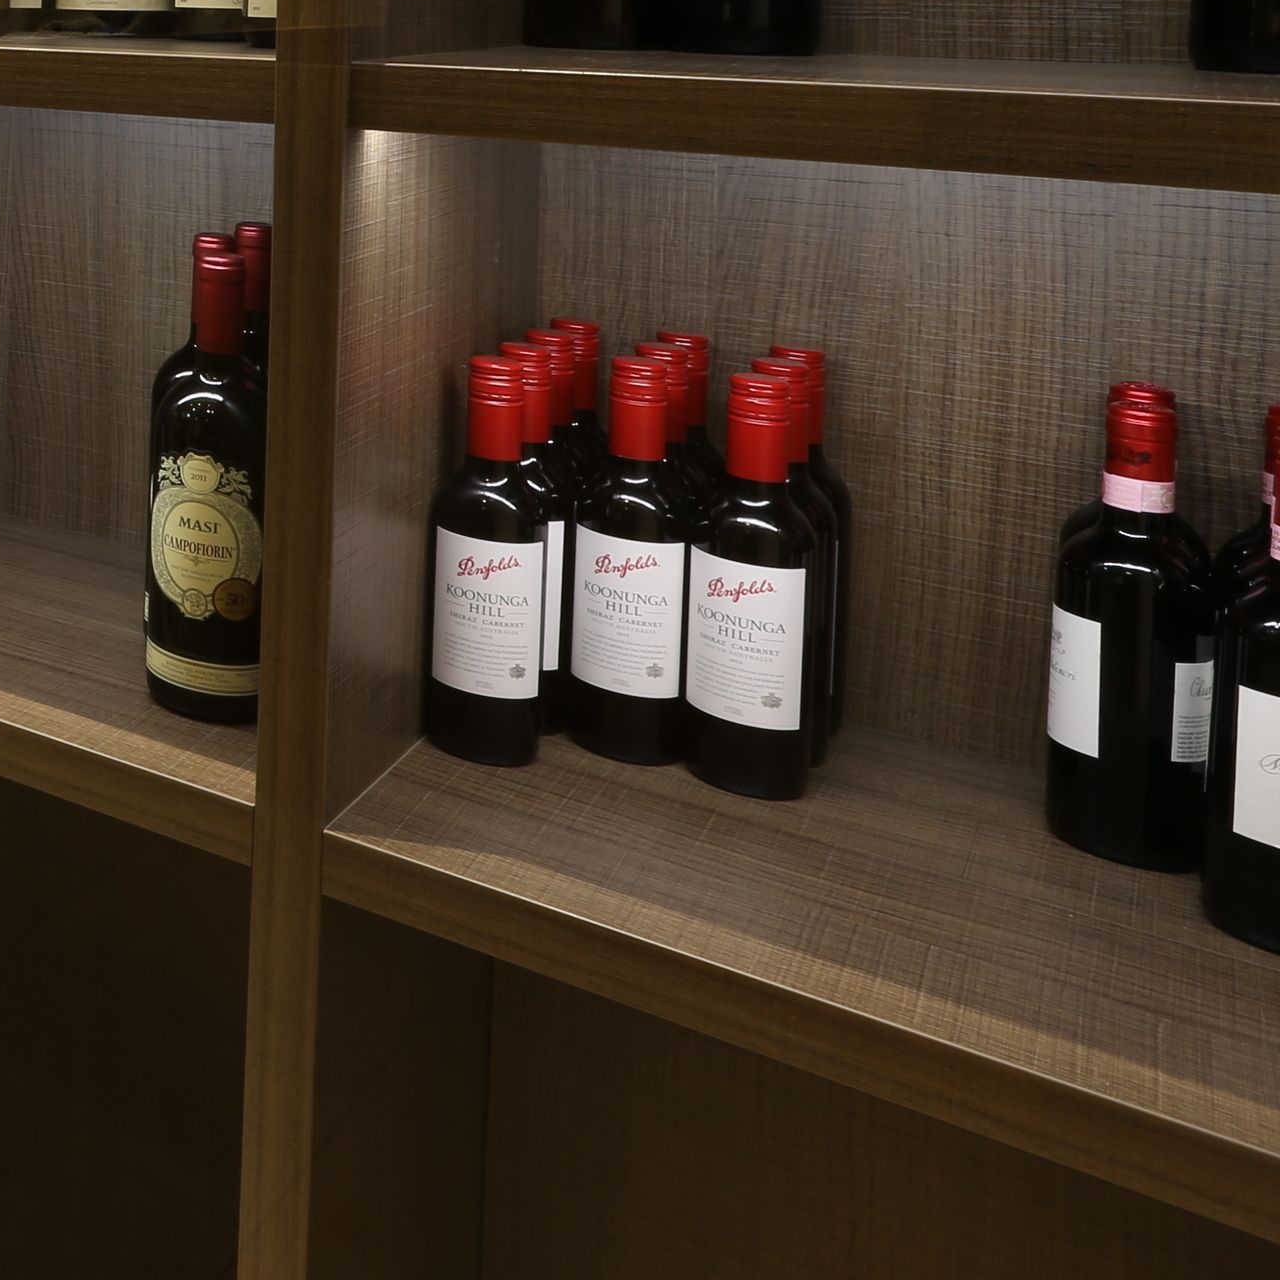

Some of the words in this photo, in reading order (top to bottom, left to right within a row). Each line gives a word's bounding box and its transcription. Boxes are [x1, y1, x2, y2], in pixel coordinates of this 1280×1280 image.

[190, 474, 207, 483] 2011
[178, 515, 218, 535] MASI
[163, 533, 234, 560] CAMPOFIORIN
[445, 583, 529, 607] KOONUNGA
[583, 580, 669, 607] KOONUNGA
[469, 602, 505, 618] HILL
[586, 607, 614, 621] SHIRAZ
[618, 617, 664, 628] CABERNET
[606, 600, 643, 617] HILL
[696, 602, 786, 635] KOONUNGA
[449, 610, 477, 623] SHIRAZ
[482, 619, 525, 629] CABERNET
[700, 631, 727, 647] SHIRAZ
[731, 643, 780, 657] CABERNET
[718, 624, 757, 644] HILL
